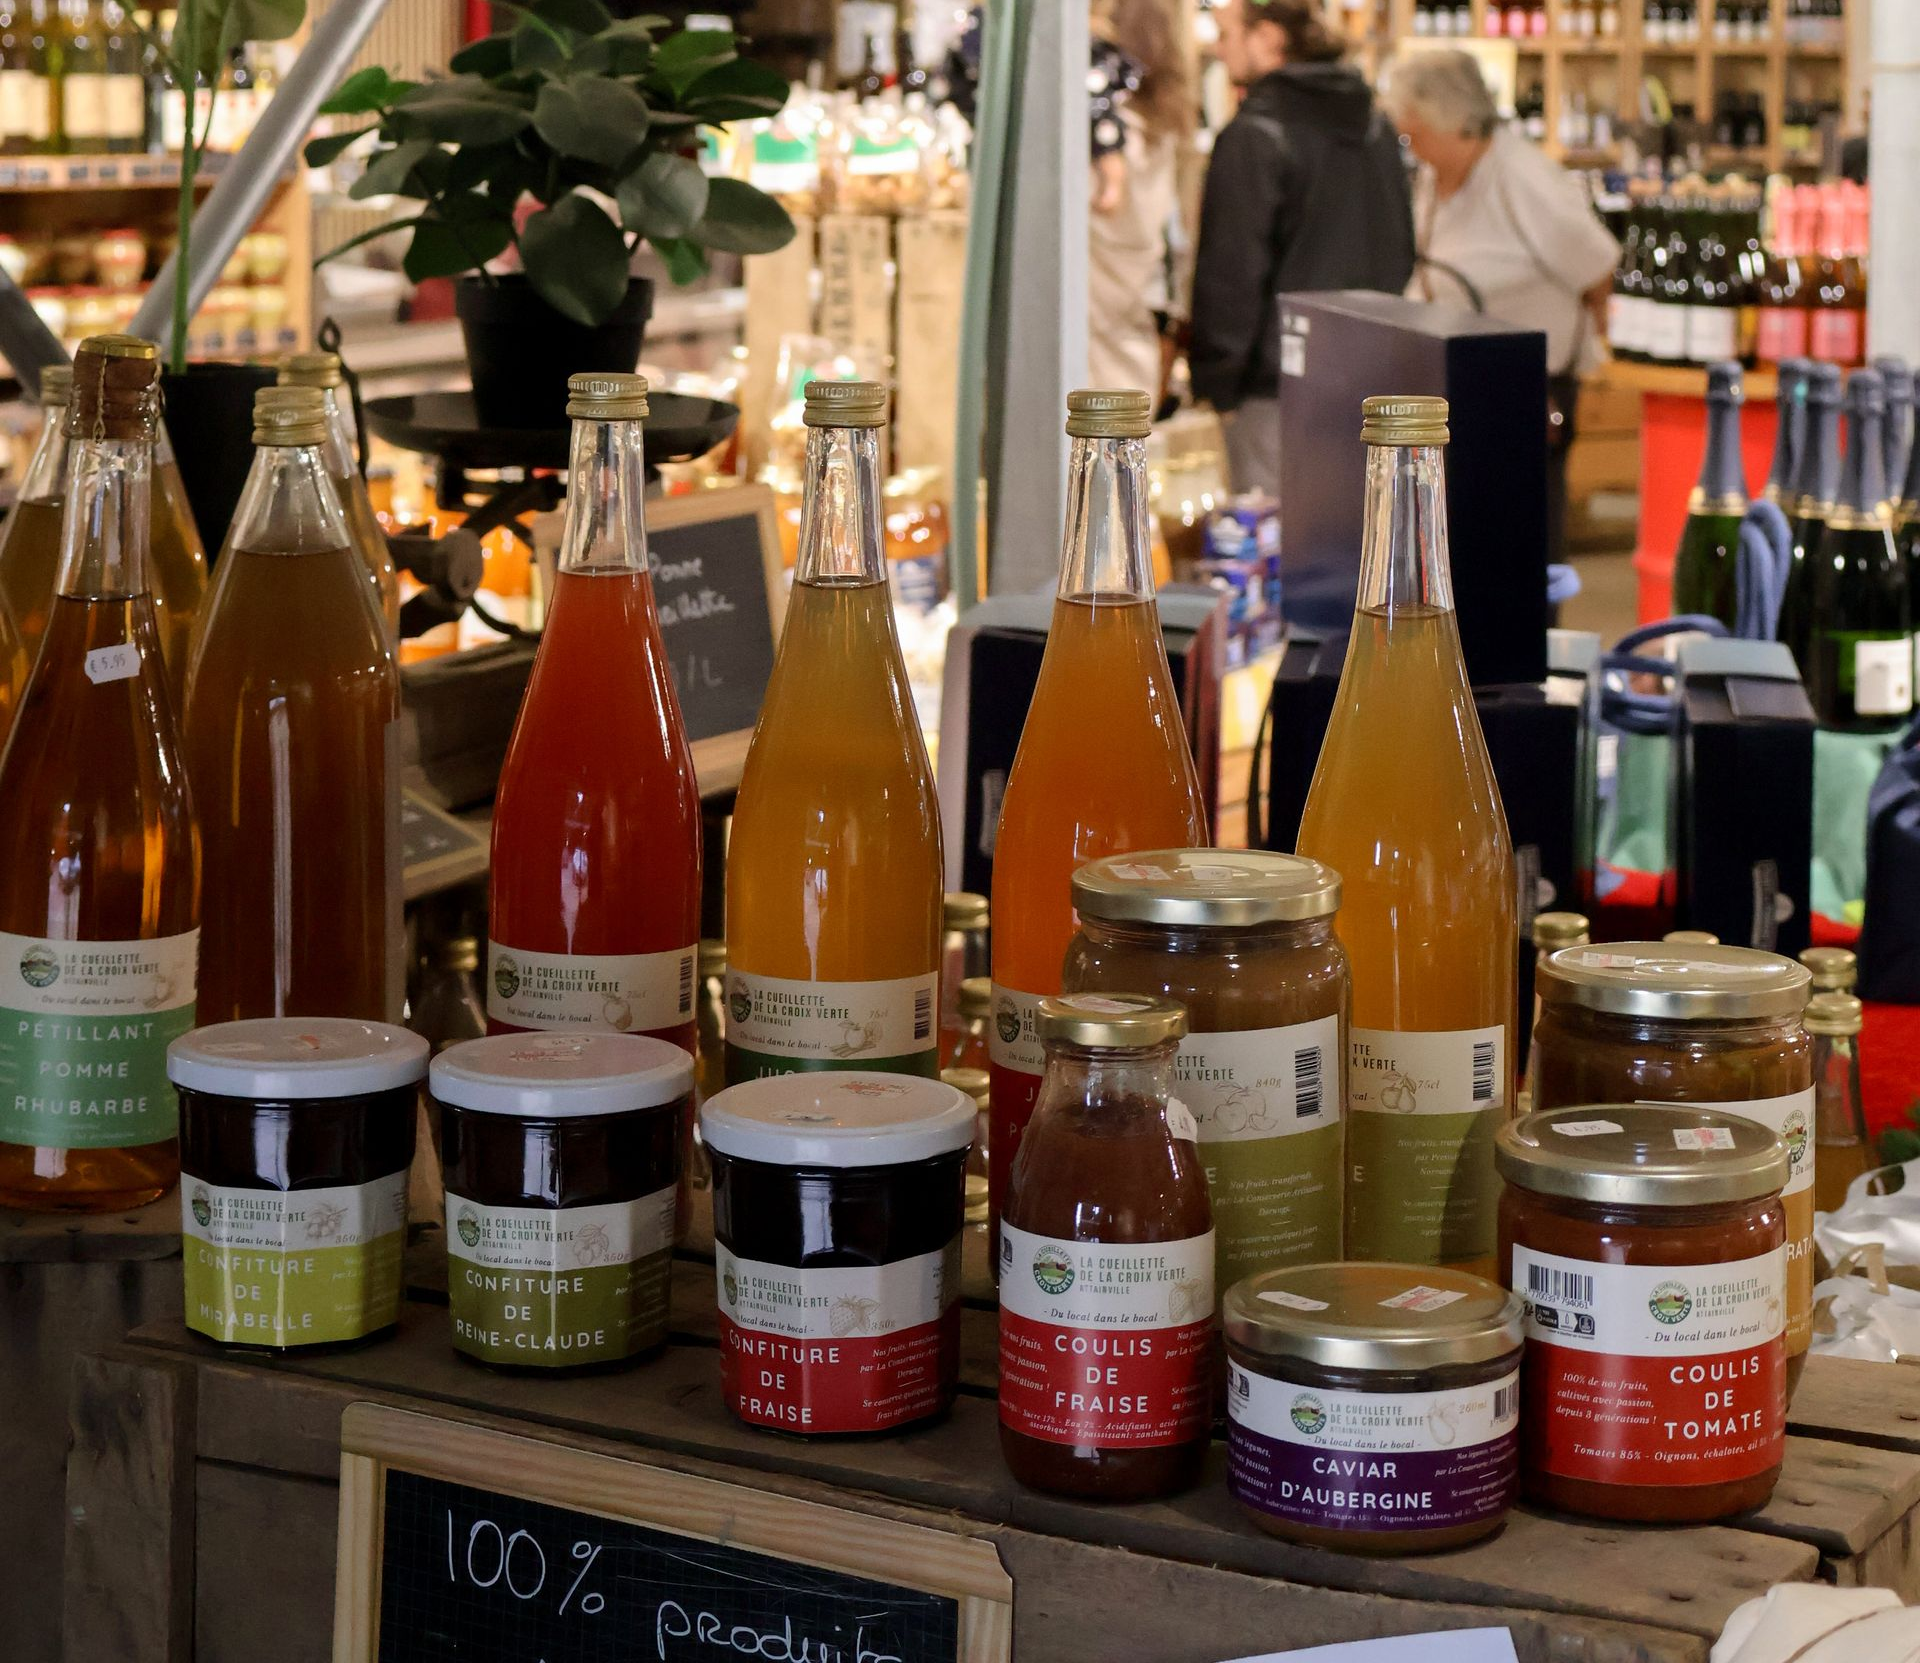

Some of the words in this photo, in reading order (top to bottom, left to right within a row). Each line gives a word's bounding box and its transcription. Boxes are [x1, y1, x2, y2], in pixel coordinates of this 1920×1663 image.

[64, 953, 76, 964] LA
[81, 953, 140, 965] CUEILLETTE
[64, 966, 76, 975] DE
[81, 966, 93, 976] LA
[98, 965, 127, 976] CROIX
[131, 962, 160, 976] VERTE
[522, 965, 533, 977] LA
[536, 967, 596, 981] CUEILLETTE
[522, 976, 532, 988] DE
[537, 978, 548, 990] LA
[551, 980, 583, 992] CROIX
[588, 981, 620, 992] VERTE
[754, 989, 763, 1000] LA
[767, 991, 825, 1007] CUEILLETTE
[536, 1010, 556, 1021] dans
[558, 1012, 567, 1022] le
[568, 1013, 592, 1023] bocal
[754, 1001, 763, 1013] DE
[767, 1003, 778, 1015] LA
[781, 1005, 811, 1018] CROIX
[816, 1008, 849, 1019] VERTE
[1023, 1008, 1033, 1020] LA
[18, 1019, 154, 1041] PÉTILLANT
[1023, 1022, 1033, 1033] DE
[766, 1034, 785, 1047] dans
[787, 1037, 796, 1048] le
[797, 1038, 821, 1050] bocal
[39, 1061, 129, 1079] POMME
[1363, 1059, 1396, 1071] VERTE
[1197, 1068, 1235, 1081] VERTE
[14, 1095, 149, 1116] RHUBARBE
[213, 1197, 223, 1207] LA
[227, 1198, 283, 1212] CUEILLETTE
[212, 1208, 224, 1219] DE
[228, 1209, 239, 1220] LA
[243, 1210, 272, 1222] CROIX
[481, 1217, 491, 1228] LA
[494, 1218, 552, 1231] CUEILLETTE
[255, 1237, 264, 1245] le
[481, 1228, 492, 1239] DE
[496, 1230, 507, 1240] LA
[511, 1230, 540, 1241] CROIX
[544, 1230, 574, 1243] VERTE
[199, 1249, 315, 1275] CONFITURE
[483, 1254, 502, 1264] local
[524, 1256, 533, 1265] le
[1080, 1256, 1094, 1269] LA
[1099, 1256, 1165, 1270] CUEILLETTE
[465, 1269, 584, 1295] CONFITURE
[1079, 1270, 1094, 1282] DE
[1099, 1270, 1112, 1283] LA
[1117, 1270, 1151, 1283] CROIX
[1157, 1267, 1185, 1282] VERTE
[233, 1284, 262, 1301] DE
[738, 1274, 749, 1285] LA
[752, 1276, 803, 1296] CUEILLETTE
[1079, 1284, 1131, 1295] ATTAINVILLE
[1696, 1286, 1708, 1297] LA
[1711, 1277, 1759, 1296] CUEILLETTE
[738, 1286, 749, 1298] DE
[752, 1288, 764, 1300] LA
[766, 1290, 793, 1306] CROIX
[796, 1294, 829, 1309] VERTE
[1695, 1297, 1708, 1308] DE
[1711, 1296, 1722, 1307] LA
[1726, 1291, 1749, 1306] CROIX
[1752, 1284, 1771, 1300] VERTE
[199, 1302, 314, 1331] MIRABELLE
[504, 1304, 532, 1321] DE
[1050, 1307, 1064, 1319] Du
[1066, 1310, 1091, 1322] local
[1093, 1311, 1118, 1323] dans
[1120, 1312, 1130, 1323] le
[1132, 1312, 1158, 1323] bocal
[740, 1313, 758, 1325] local
[758, 1318, 777, 1329] dans
[778, 1320, 787, 1331] le
[787, 1322, 807, 1334] bocal
[1654, 1331, 1671, 1342] Du
[1674, 1329, 1701, 1342] local
[1703, 1328, 1727, 1341] dans
[1729, 1326, 1737, 1338] le
[1739, 1320, 1760, 1336] bocal
[456, 1318, 606, 1351] REINE-CLAUDE
[729, 1328, 840, 1364] CONFITURE
[1054, 1334, 1153, 1357] COULIS
[1164, 1348, 1178, 1360] par
[1178, 1346, 1189, 1355] La
[860, 1365, 874, 1373] par
[876, 1363, 886, 1371] La
[1086, 1366, 1119, 1385] DE
[1669, 1355, 1759, 1384] COULIS
[760, 1370, 786, 1391] DE
[1562, 1372, 1586, 1385] 100%
[1587, 1376, 1599, 1386] de
[1601, 1379, 1617, 1389] nos
[1618, 1380, 1649, 1392] fruits,
[862, 1399, 873, 1408] Se
[1055, 1391, 1150, 1414] FRAISE
[1557, 1389, 1590, 1402] cultivés
[1592, 1395, 1613, 1405] avec
[1616, 1397, 1655, 1408] passion,
[1704, 1389, 1734, 1411] DE
[740, 1395, 813, 1425] FRAISE
[1330, 1403, 1340, 1413] LA
[1345, 1404, 1403, 1416] CUEILLETTE
[1555, 1404, 1583, 1418] depuis
[1585, 1409, 1592, 1419] 3
[1593, 1412, 1650, 1425] générations
[1022, 1408, 1041, 1421] Sucre
[1104, 1422, 1152, 1431] Acidifiants
[1029, 1421, 1067, 1435] ascorbique
[1330, 1414, 1341, 1424] DE
[1345, 1415, 1358, 1426] LA
[1361, 1416, 1391, 1427] CROIX
[1395, 1416, 1424, 1427] VERTE
[1663, 1409, 1763, 1440] TOMATE
[1314, 1435, 1327, 1445] Du
[1329, 1436, 1352, 1448] local
[1354, 1438, 1377, 1449] dans
[1379, 1439, 1388, 1449] le
[1390, 1439, 1415, 1449] bocal
[1573, 1443, 1616, 1459] Tomates
[1619, 1450, 1641, 1460] 85%
[1654, 1451, 1700, 1464] Oignons,
[1703, 1445, 1746, 1459] échalotes,
[1747, 1439, 1758, 1452] ail
[1312, 1456, 1398, 1479] CAVIAR
[1281, 1480, 1433, 1510] D'AUBERGINE
